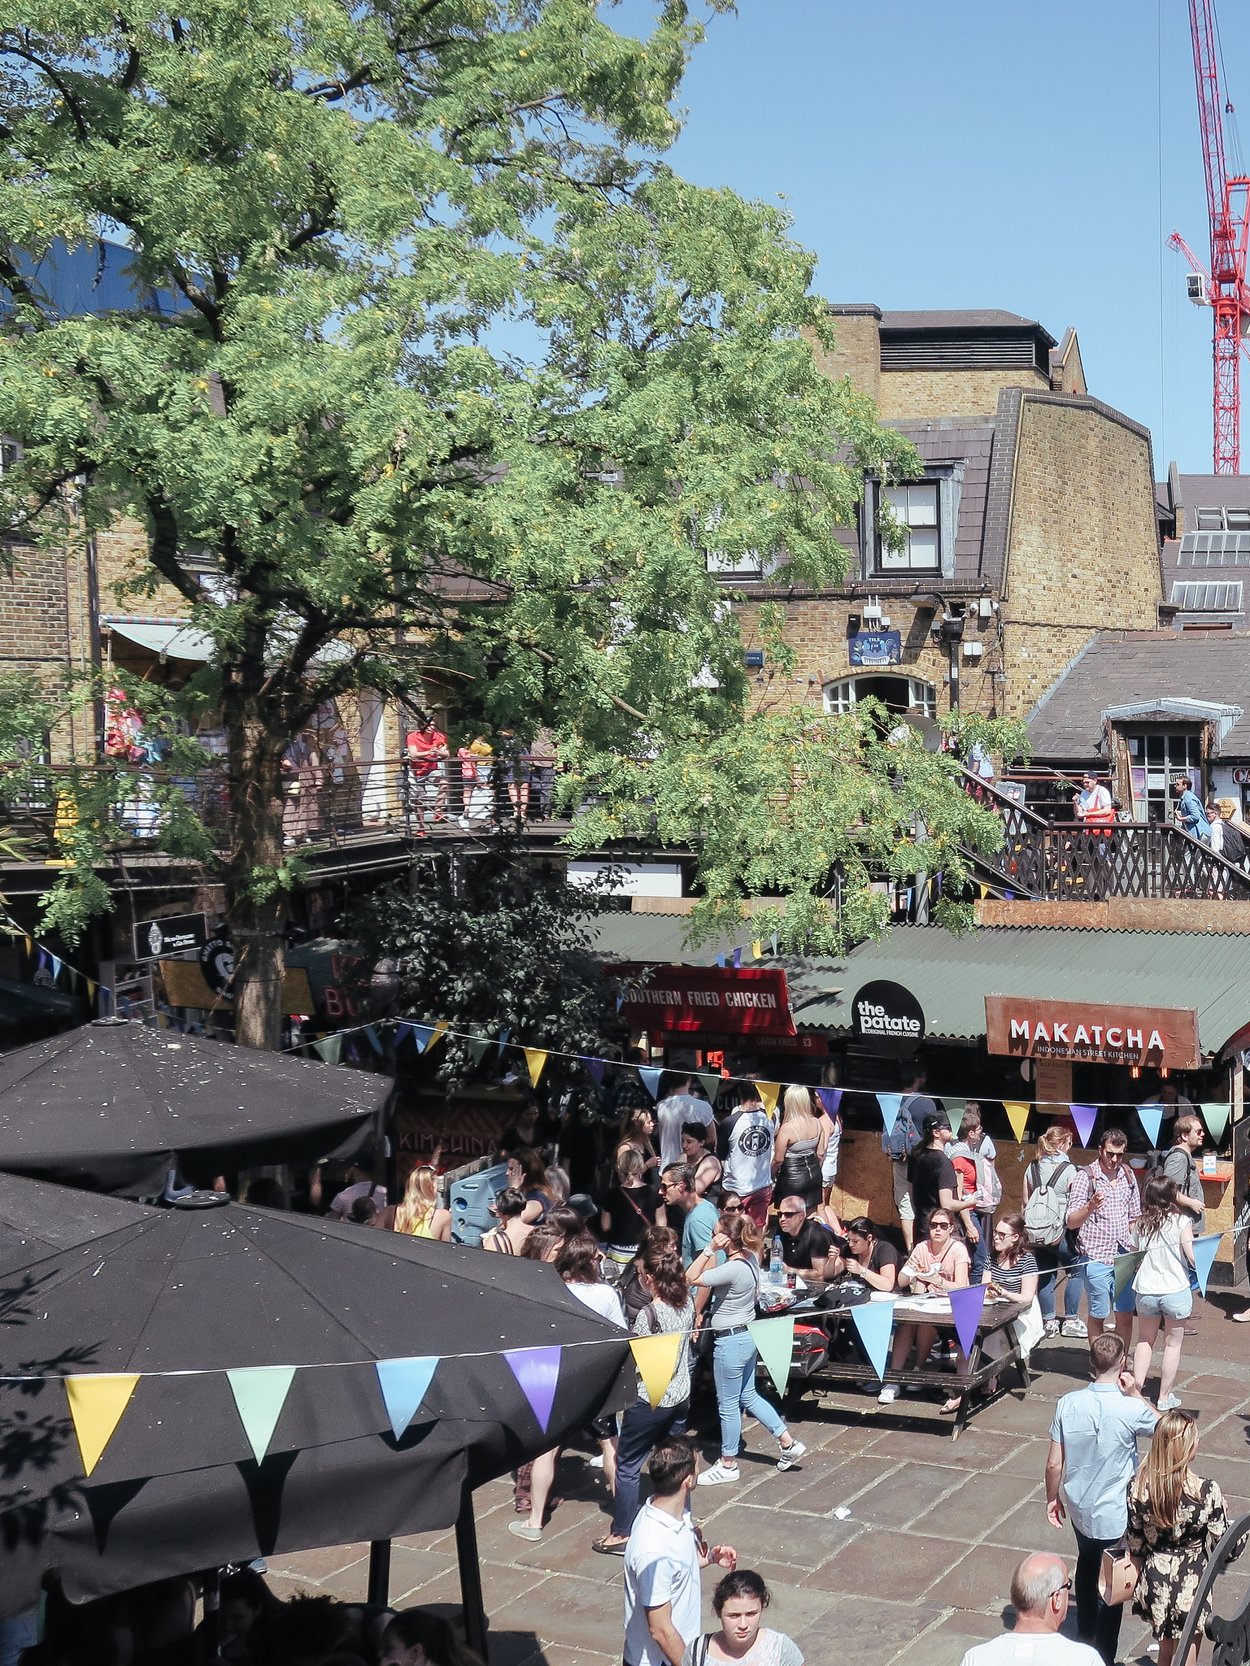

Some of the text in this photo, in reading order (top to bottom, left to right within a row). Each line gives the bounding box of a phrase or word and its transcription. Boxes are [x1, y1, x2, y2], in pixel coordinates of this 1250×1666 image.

[623, 989, 777, 1009] SOUTHERN FRIED CHICKEN
[857, 1001, 885, 1016] the
[860, 1015, 921, 1034] patate
[1010, 1018, 1166, 1050] MAKATCHA
[1037, 1045, 1139, 1060] INDONESIAN STREET KITCHEN
